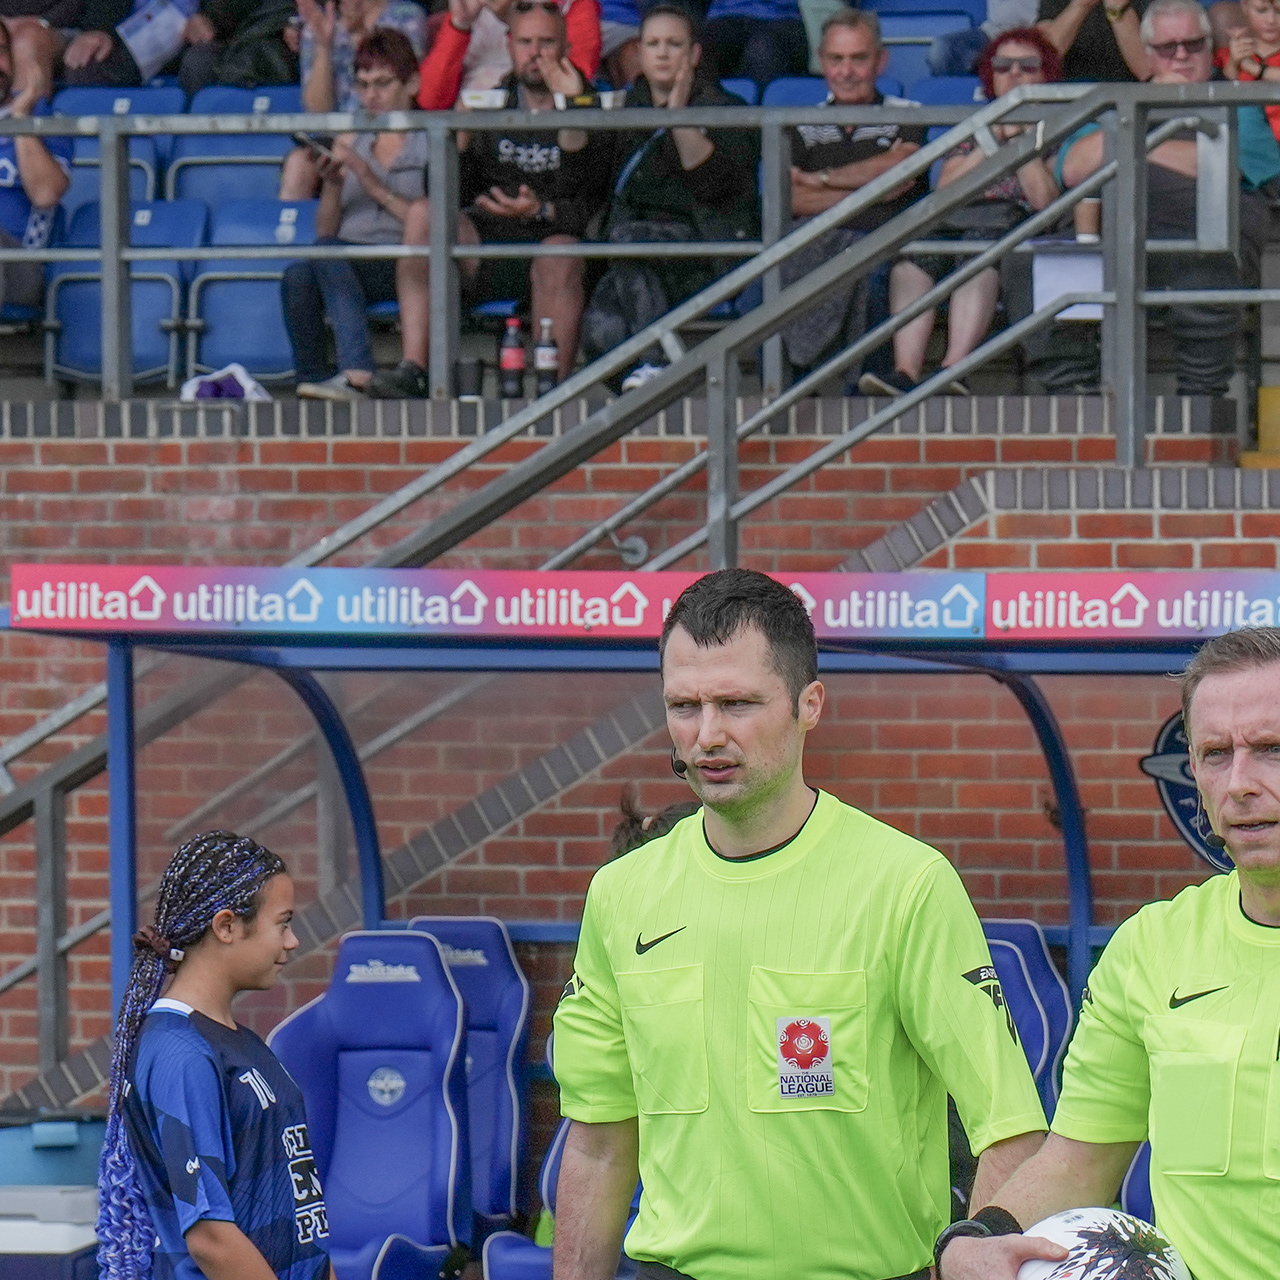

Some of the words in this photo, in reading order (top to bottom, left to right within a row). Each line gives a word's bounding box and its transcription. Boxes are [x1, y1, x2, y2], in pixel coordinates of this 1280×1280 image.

[17, 583, 128, 620] utilita
[173, 585, 286, 624] utilita
[337, 586, 450, 625] utilita
[496, 587, 610, 627] utilita
[824, 590, 939, 628] utilita
[992, 589, 1104, 629] utilita
[1157, 588, 1275, 628] utilita
[780, 1074, 832, 1084] NATIONAL
[780, 1082, 833, 1094] LEAGUE
